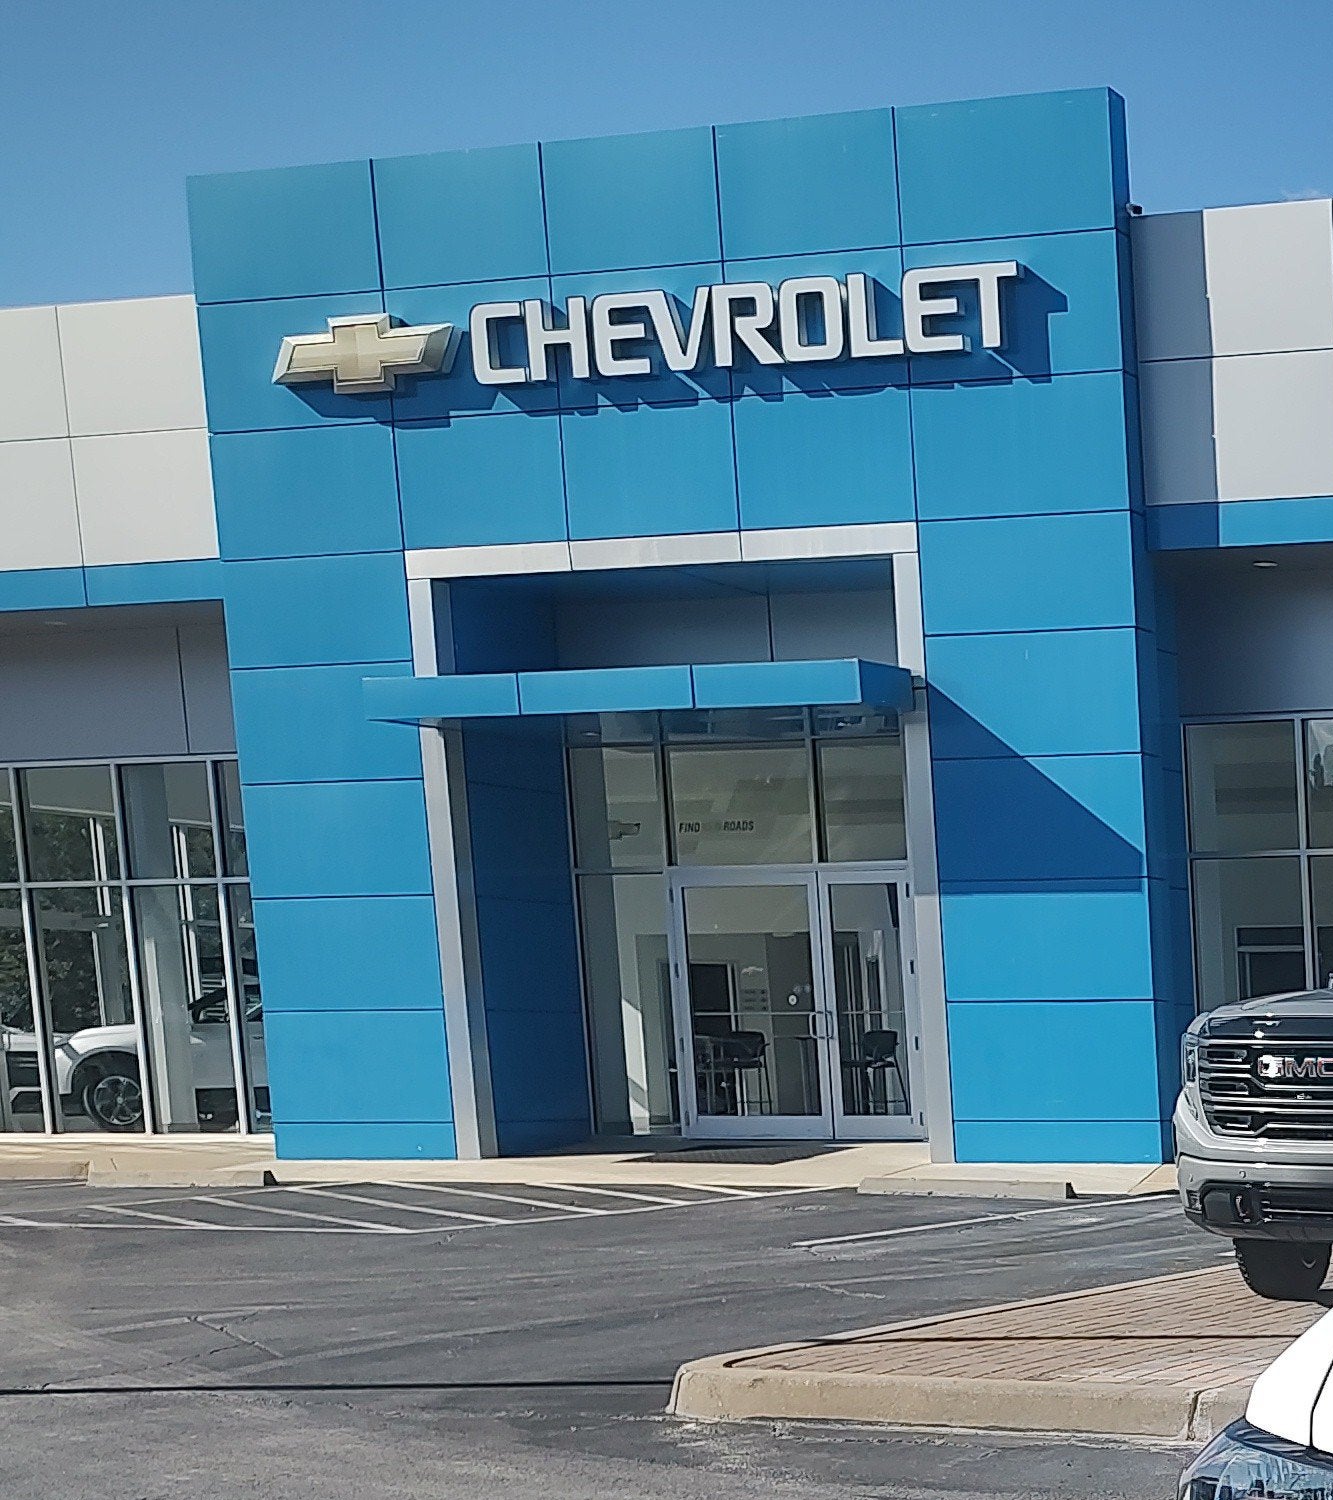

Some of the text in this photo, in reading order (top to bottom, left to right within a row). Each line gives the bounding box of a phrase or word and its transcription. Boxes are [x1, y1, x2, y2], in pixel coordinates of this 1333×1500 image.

[469, 259, 1018, 386] CHEVROLET
[679, 820, 754, 833] FIND ROADS
